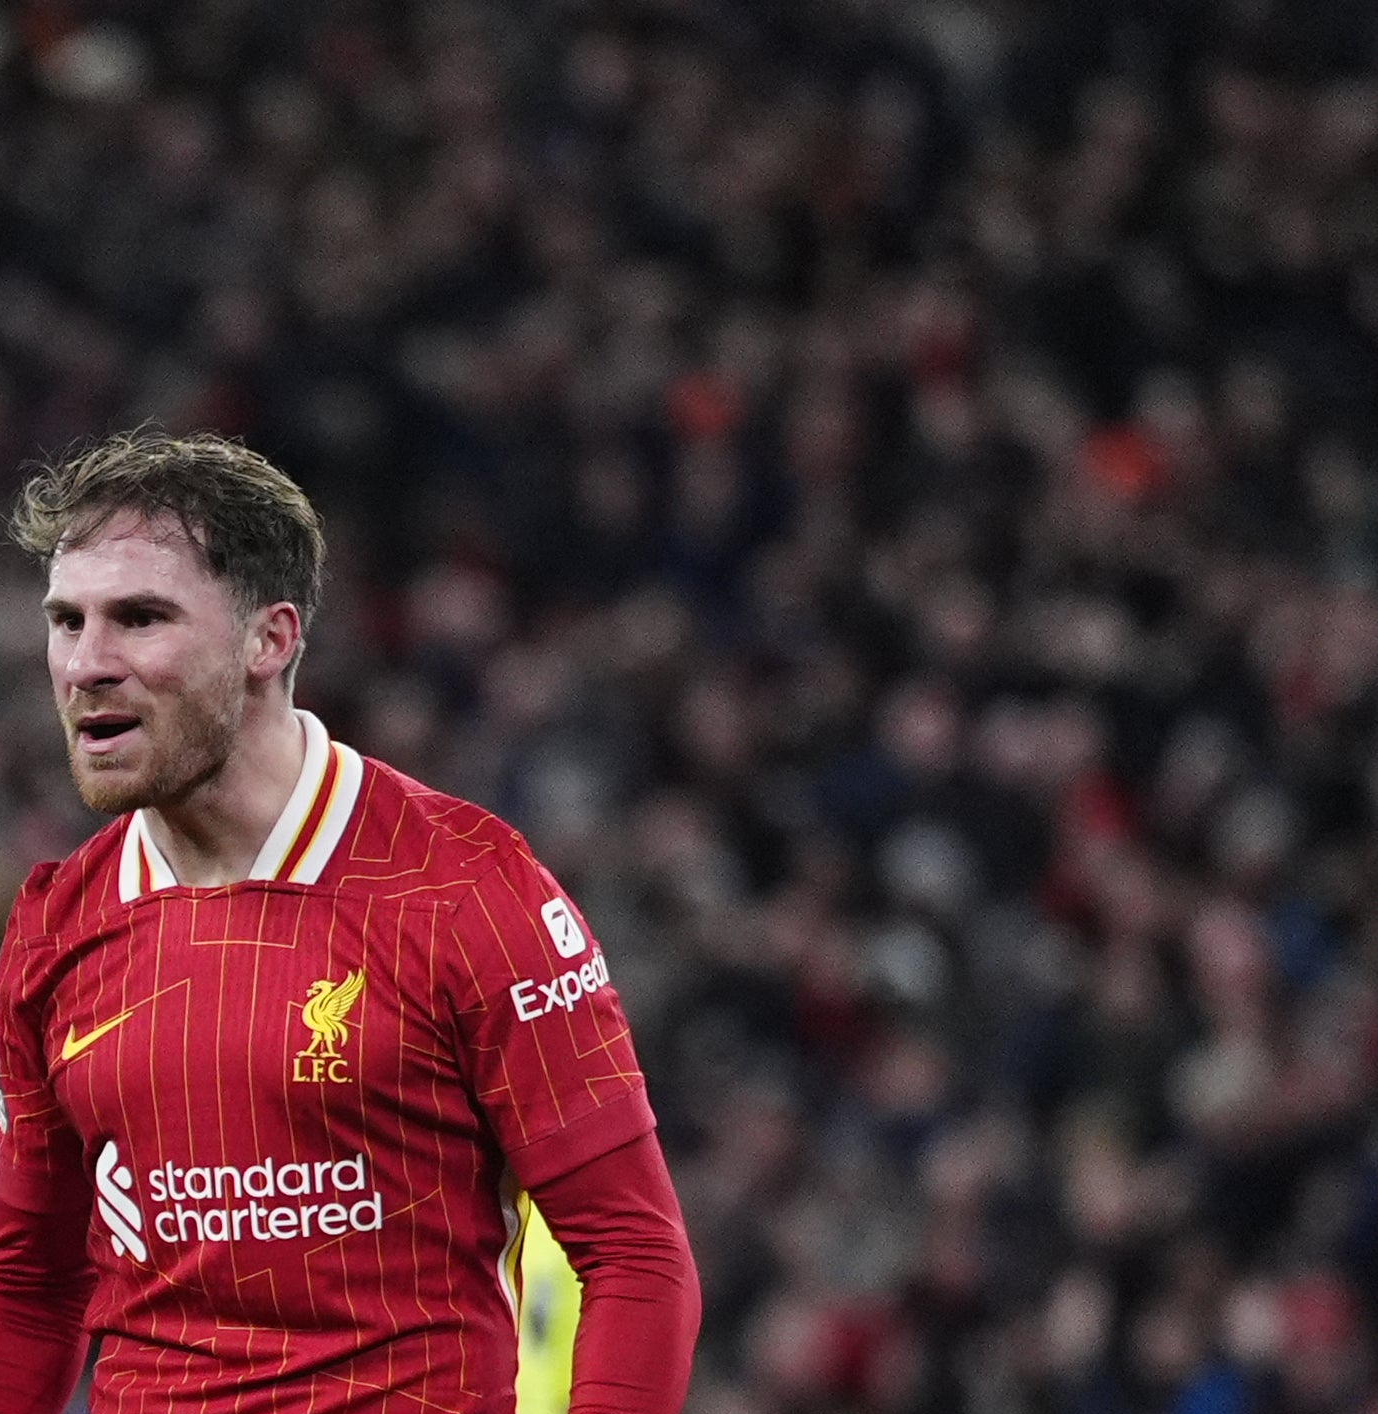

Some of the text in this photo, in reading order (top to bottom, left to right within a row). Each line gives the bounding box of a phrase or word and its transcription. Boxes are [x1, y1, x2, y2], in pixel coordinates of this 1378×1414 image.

[293, 1058, 353, 1083] L.F.C.
[149, 1152, 365, 1202] standard
[155, 1191, 383, 1243] chartered
